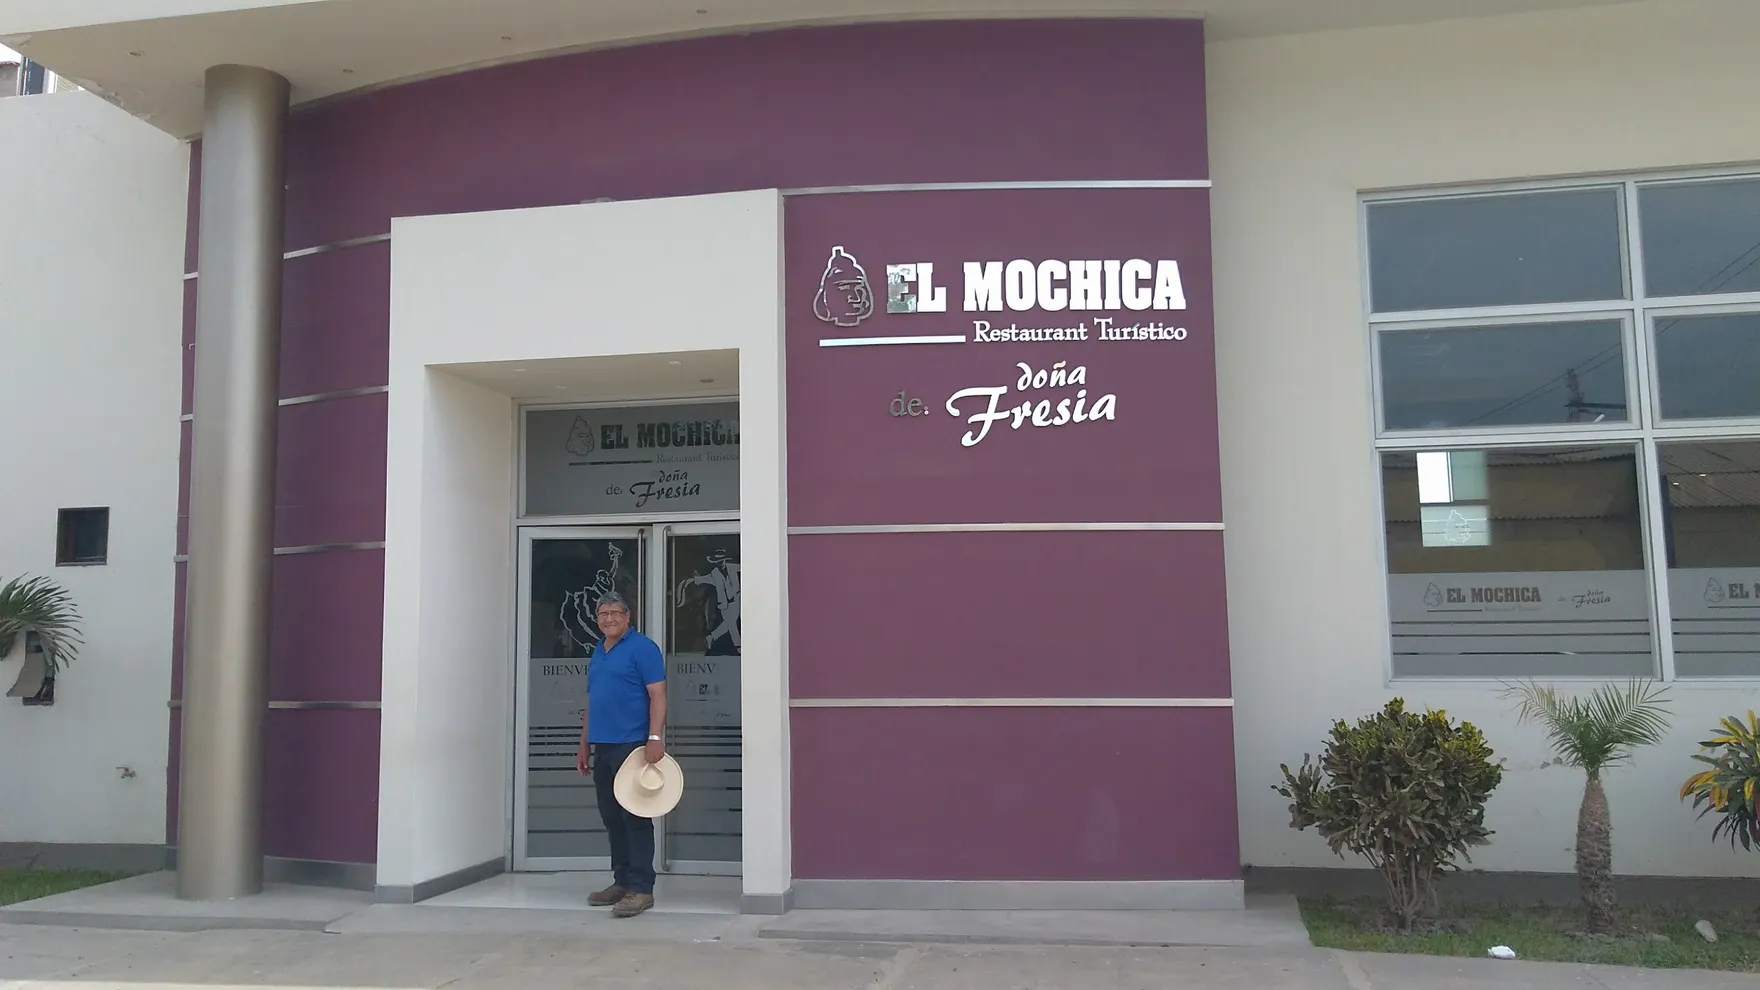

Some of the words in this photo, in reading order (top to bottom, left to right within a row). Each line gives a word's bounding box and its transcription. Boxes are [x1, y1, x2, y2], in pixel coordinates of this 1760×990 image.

[886, 262, 947, 313] EL
[962, 259, 1187, 312] MOCHICA
[973, 320, 1089, 343] Restaurant
[1093, 317, 1188, 341] Turístico
[1016, 360, 1087, 391] doña
[945, 384, 1117, 448] Fresia
[601, 424, 630, 450] EL
[659, 469, 688, 484] doña
[629, 481, 701, 508] Fresia
[1446, 588, 1466, 603] EL
[1471, 586, 1542, 604] MOCHICA
[1728, 583, 1750, 599] EL
